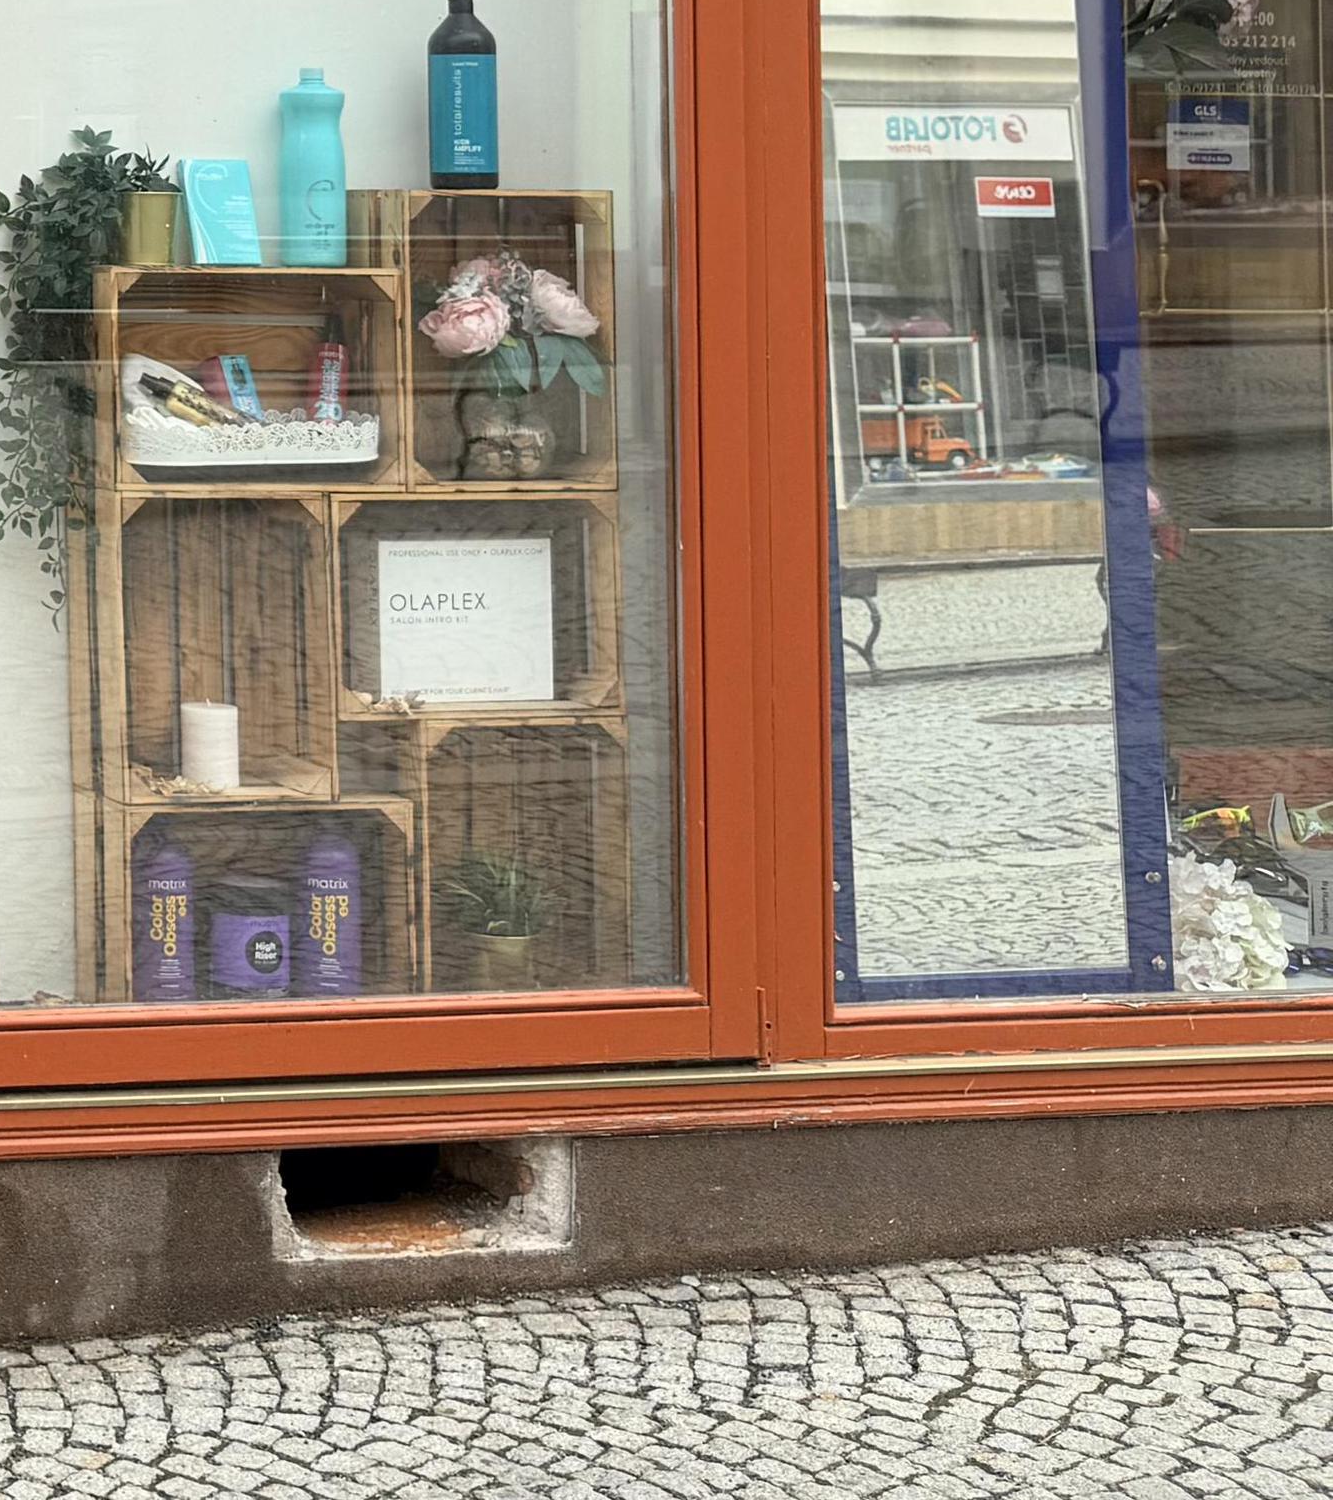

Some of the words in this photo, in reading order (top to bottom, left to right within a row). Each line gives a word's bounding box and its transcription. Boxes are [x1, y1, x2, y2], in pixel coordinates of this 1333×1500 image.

[1243, 35, 1268, 48] 212
[1271, 35, 1297, 49] 214
[1194, 105, 1217, 117] GLS
[390, 616, 422, 625] SALON
[148, 878, 188, 891] matrix
[307, 877, 349, 890] matrix
[150, 895, 164, 941] Color
[309, 894, 322, 940] Color
[163, 895, 177, 957] Obsess
[322, 895, 336, 956] Obsess
